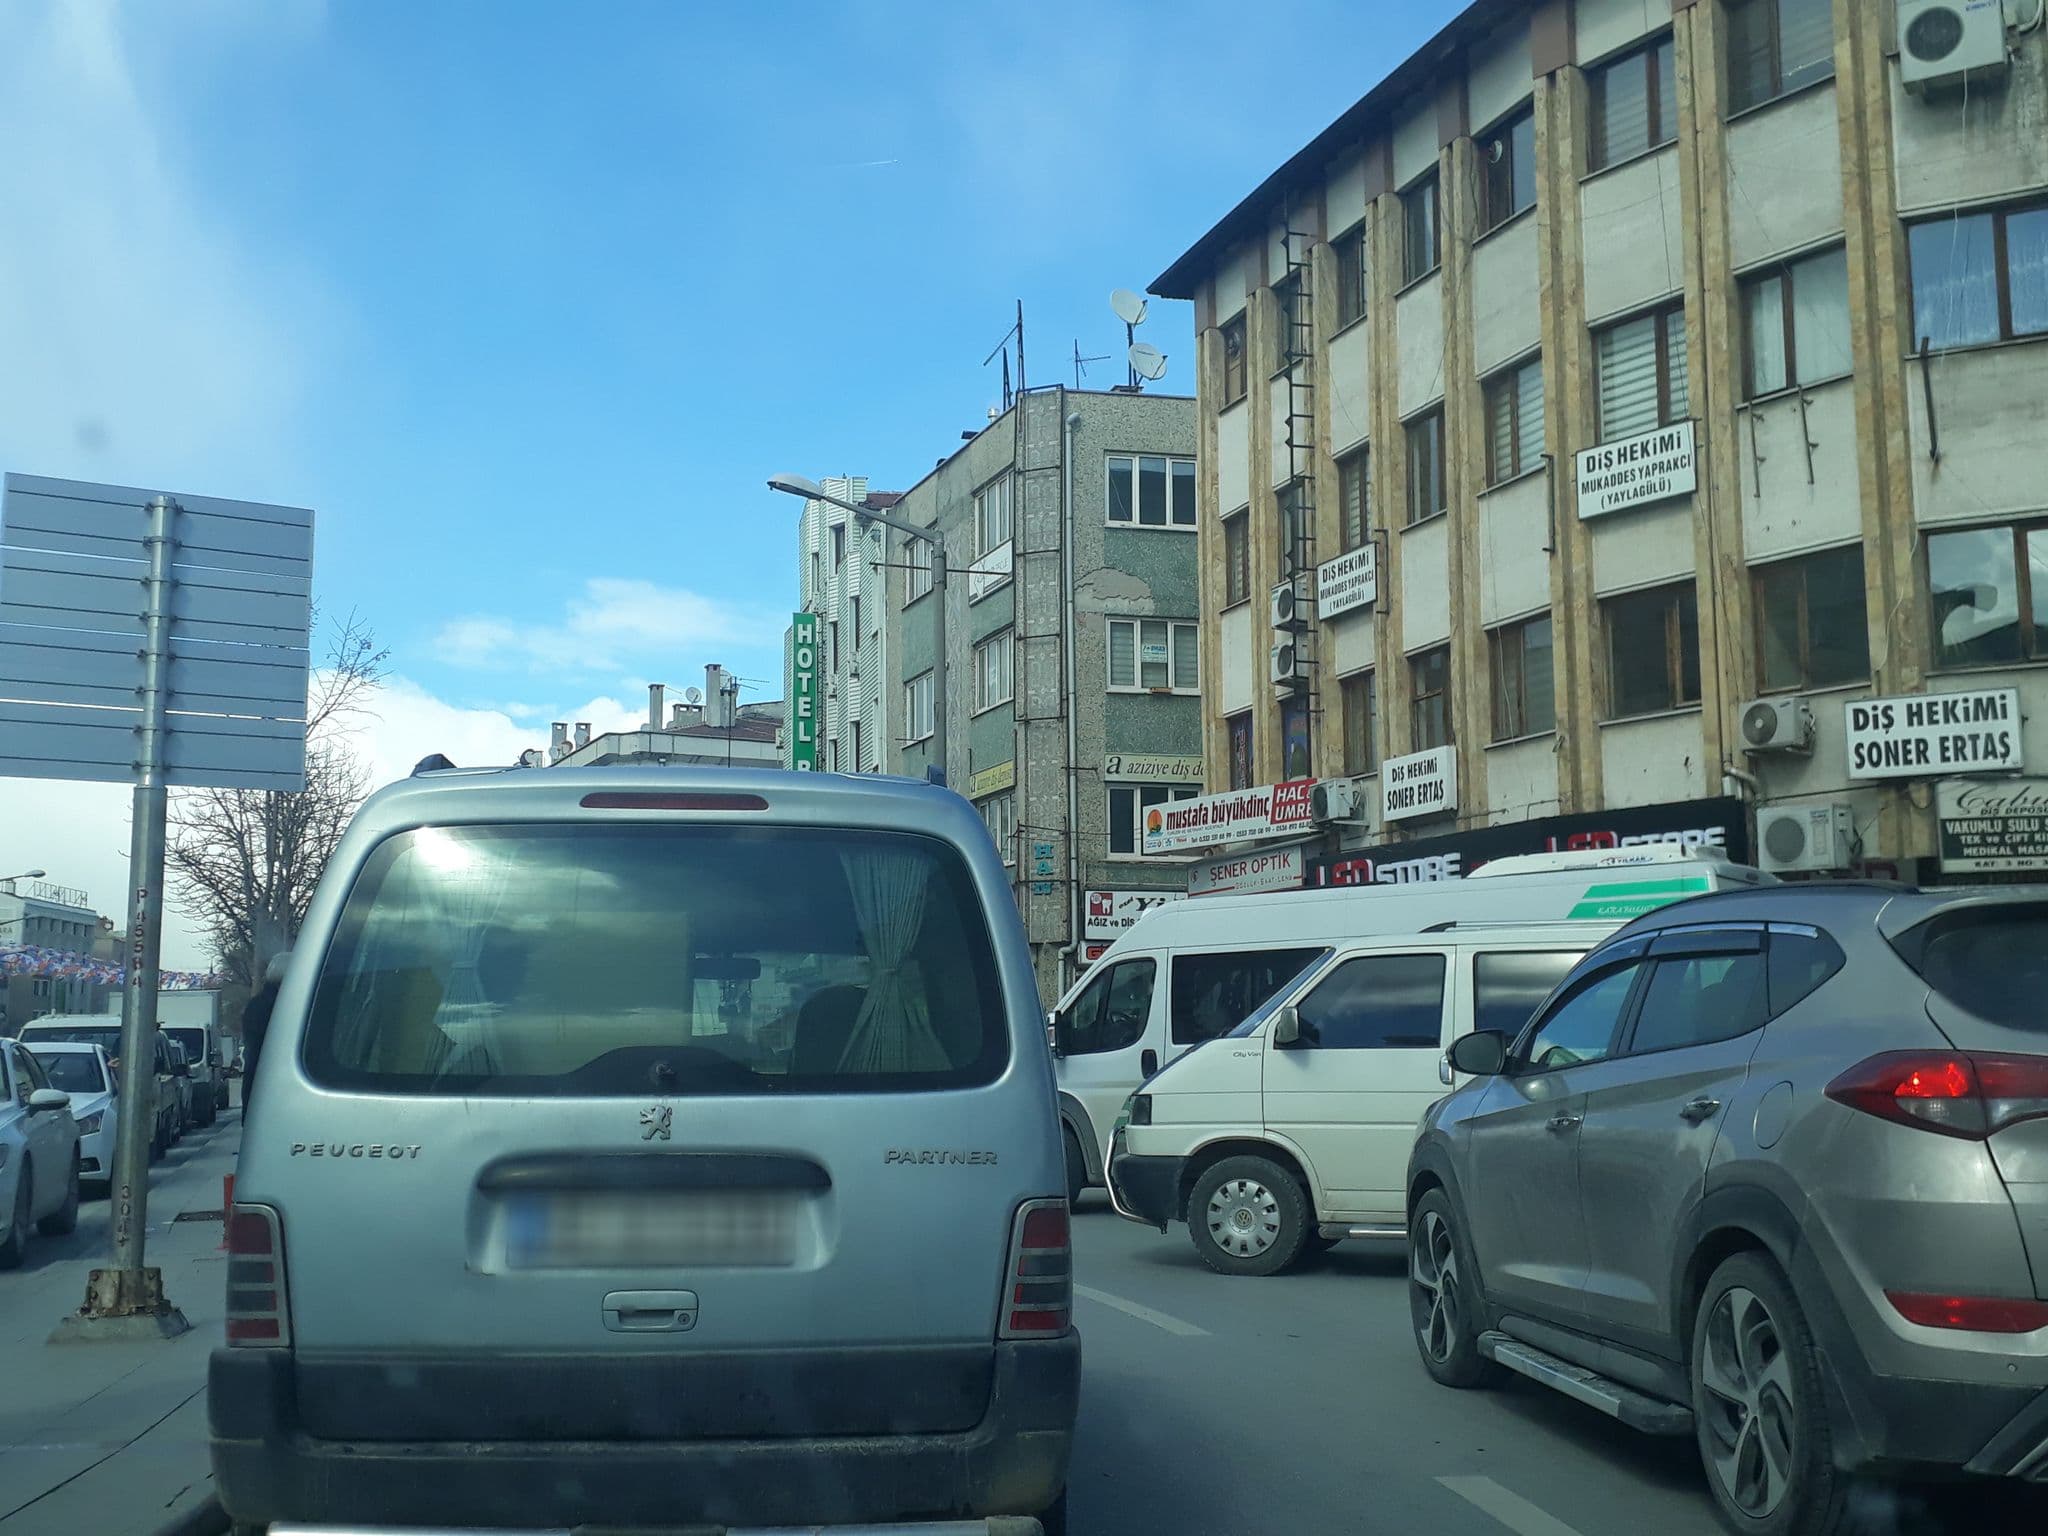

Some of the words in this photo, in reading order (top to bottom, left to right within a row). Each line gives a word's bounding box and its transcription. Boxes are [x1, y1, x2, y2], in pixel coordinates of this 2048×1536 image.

[1581, 468, 1636, 495] MUKADDES
[797, 623, 812, 742] HOTEL
[1854, 738, 1930, 769] SONER
[1939, 731, 2011, 764] ERTAŞ
[1127, 758, 1169, 778] aziziye
[1171, 759, 1190, 780] diş
[1387, 786, 1415, 811] SONER
[1417, 779, 1444, 804] ERTAŞ
[1166, 803, 1209, 831] mustafa
[1211, 794, 1270, 826] büyükdinç
[1275, 802, 1312, 821] UMRE
[1946, 819, 2002, 835] VAKUMLU
[2007, 818, 2039, 832] SULU
[1960, 835, 1981, 844] TEK
[1209, 861, 1247, 887] ŞENER
[1251, 851, 1291, 874] OPTİK
[1087, 917, 1109, 928] AĞIZ
[1109, 919, 1119, 928] ve
[290, 1143, 421, 1159] PEUGEOT
[884, 1150, 998, 1165] PARTNER
